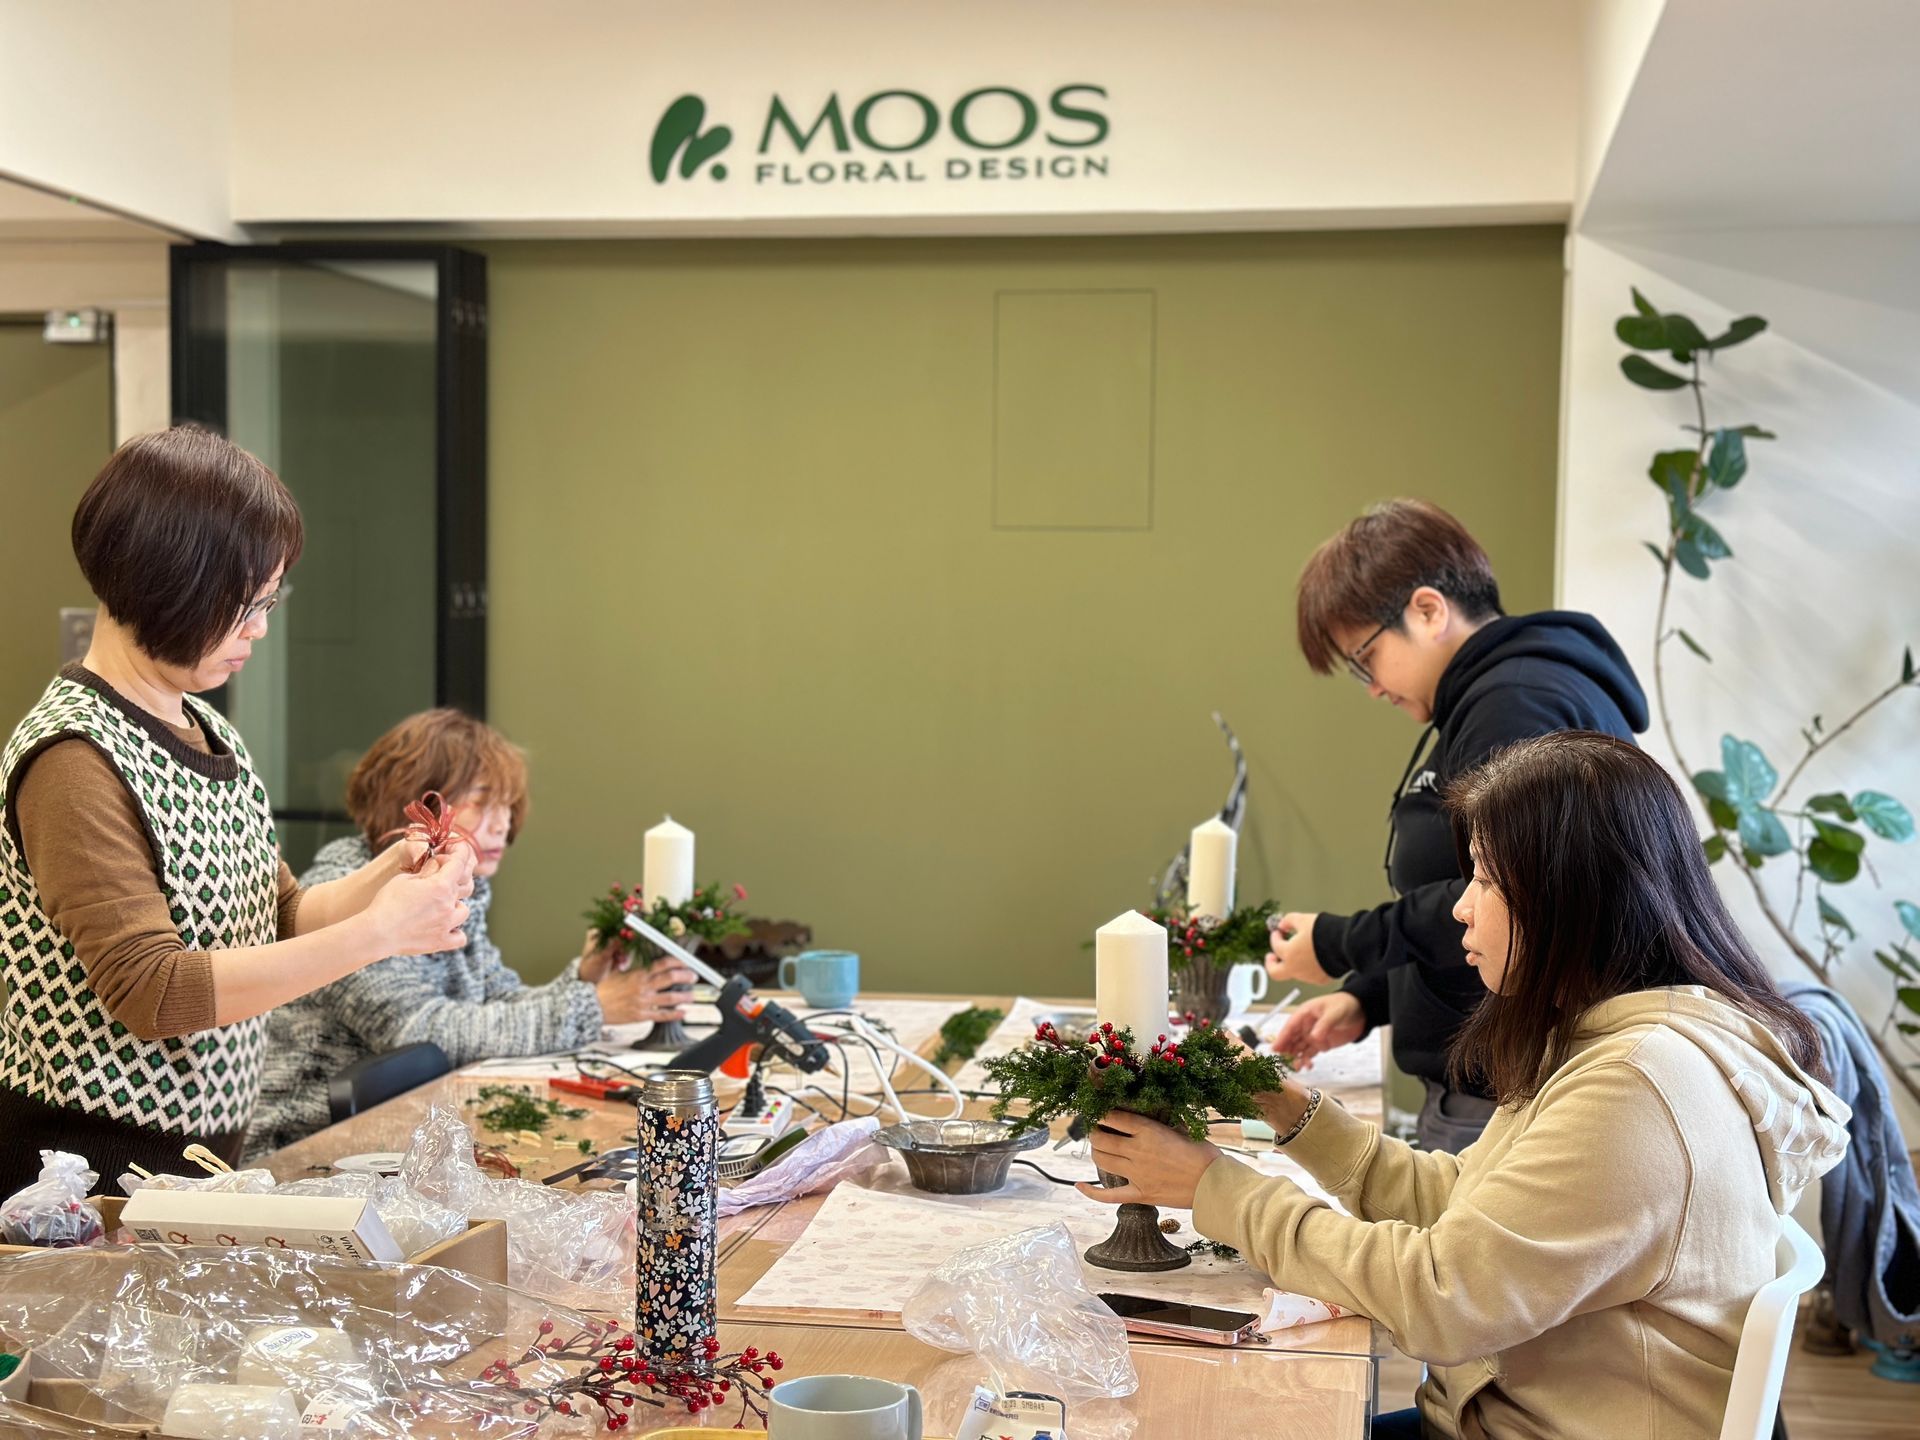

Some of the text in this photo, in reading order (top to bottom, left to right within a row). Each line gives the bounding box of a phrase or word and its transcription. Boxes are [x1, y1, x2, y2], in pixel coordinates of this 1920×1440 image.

[758, 83, 1111, 155] MOOS
[756, 154, 1109, 184] FLORAL DESIGN
